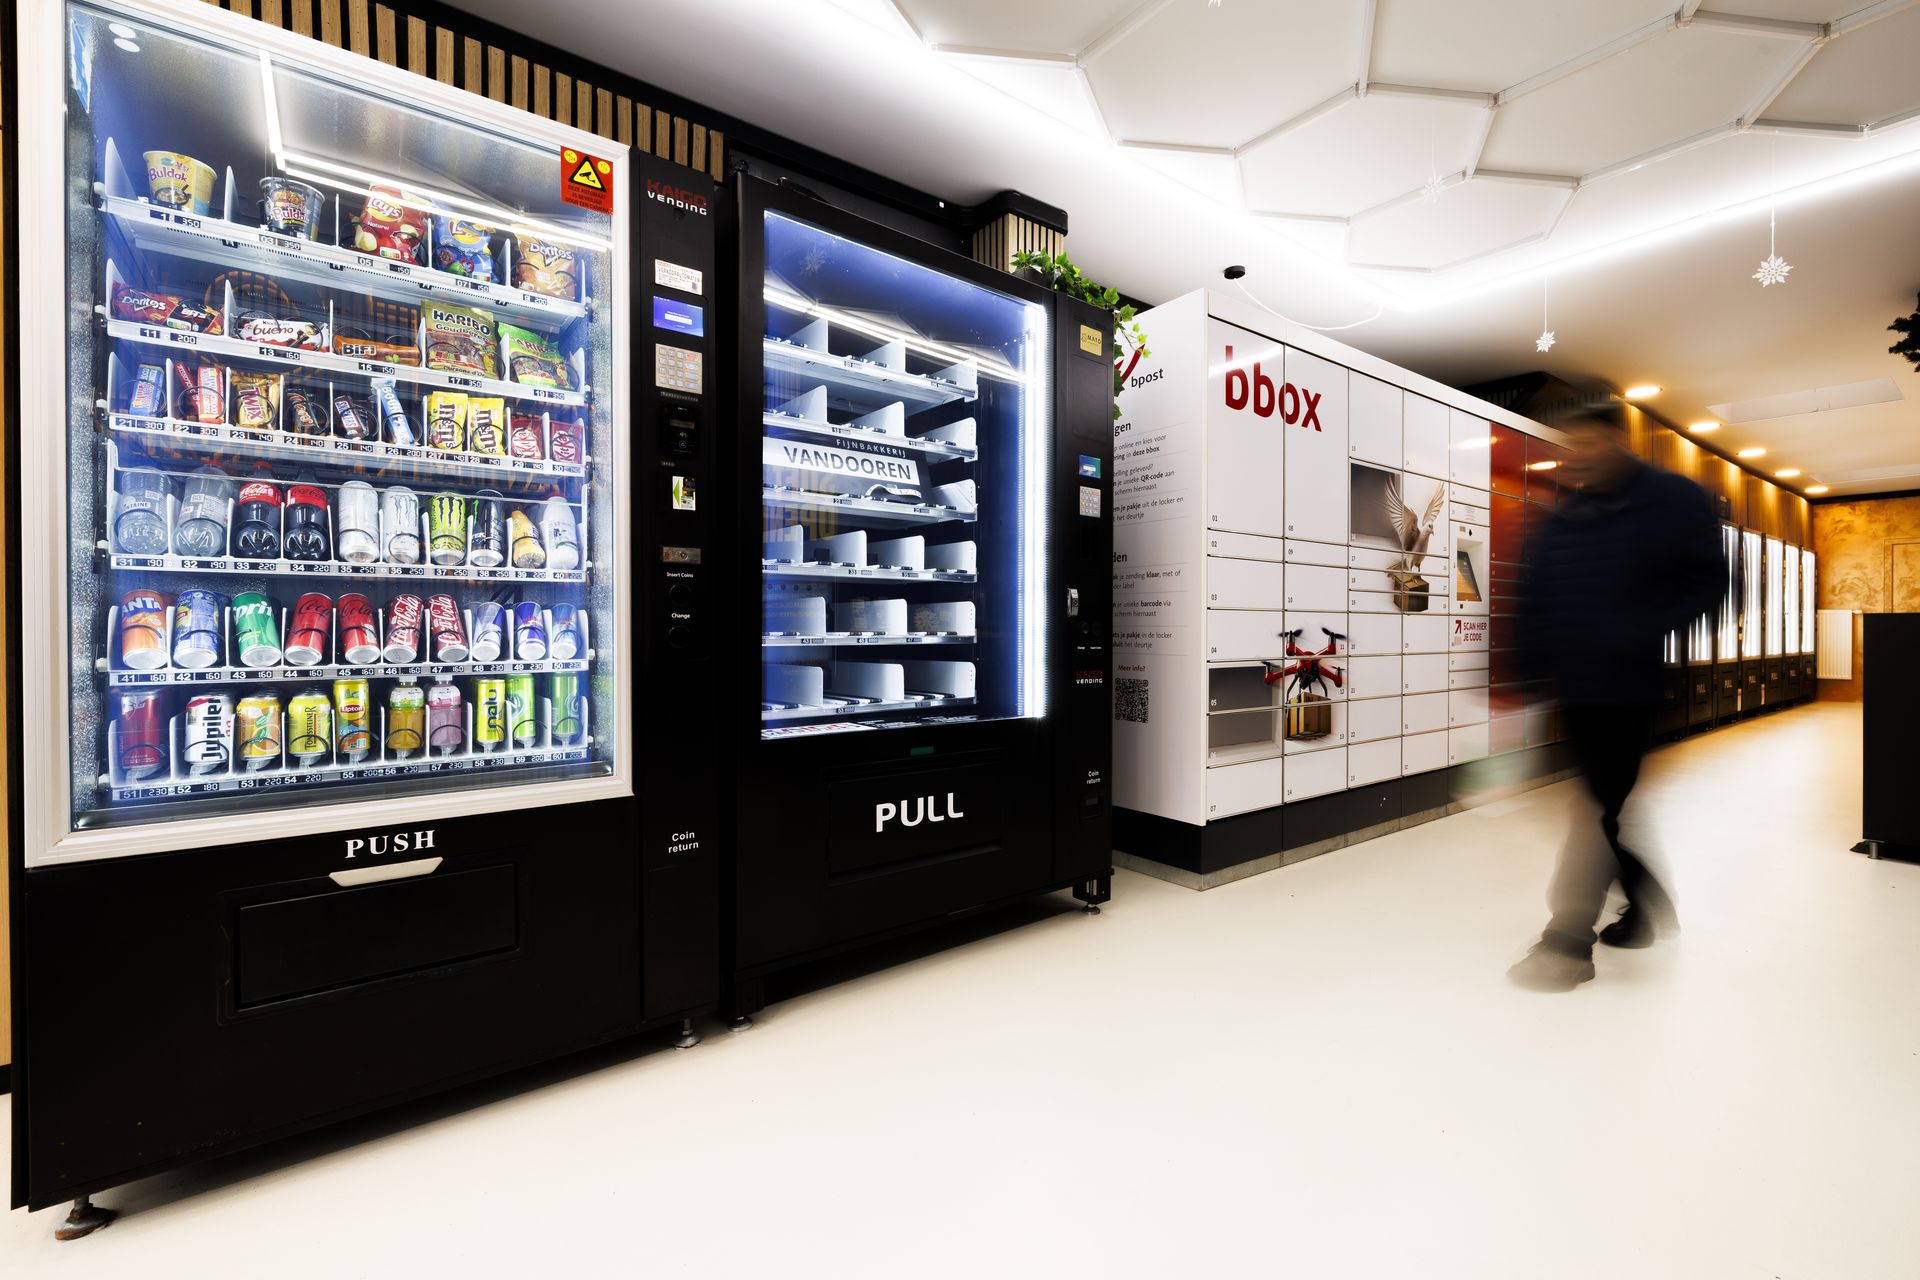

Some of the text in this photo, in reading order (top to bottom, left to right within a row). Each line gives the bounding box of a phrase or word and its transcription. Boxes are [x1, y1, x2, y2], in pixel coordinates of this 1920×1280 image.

[149, 167, 188, 183] Buldak
[648, 191, 707, 216] VENDING
[529, 242, 573, 260] Doritos
[122, 296, 166, 310] Doritos
[433, 310, 491, 336] HARIBO
[144, 329, 157, 337] 11
[253, 324, 294, 335] bueno
[262, 348, 275, 356] 13
[361, 364, 373, 372] 15
[450, 377, 460, 385] 17
[1131, 368, 1164, 388] bpost
[1226, 346, 1322, 433] bbox
[239, 388, 263, 420] TWIX
[120, 419, 133, 428] 21
[176, 425, 190, 433] 22
[233, 431, 246, 439] 23
[286, 436, 299, 445] 24
[336, 442, 350, 450] 25
[836, 439, 906, 458] FIJNBAKKERIJ
[1133, 449, 1145, 457] deze
[1146, 446, 1160, 454] bbox
[784, 446, 912, 480] VANDOOREN
[1140, 472, 1163, 482] QR-code
[1126, 503, 1141, 512] pakje
[1158, 498, 1175, 506] locker
[184, 560, 198, 568] 32
[341, 565, 352, 573] 35
[1463, 622, 1476, 631] SCAN
[1469, 633, 1482, 642] CODE
[122, 674, 135, 682] 41
[177, 673, 191, 681] 42
[341, 704, 363, 713] Lipton
[485, 689, 497, 729] nalu
[201, 698, 225, 761] Jupiler
[241, 778, 282, 788] 53 220
[124, 788, 167, 799] 51 230
[177, 785, 192, 794] 52
[876, 792, 964, 833] PULL
[1210, 805, 1217, 813] 07
[672, 831, 695, 842] Coin
[345, 830, 435, 859] PUSH
[668, 842, 699, 854] return
